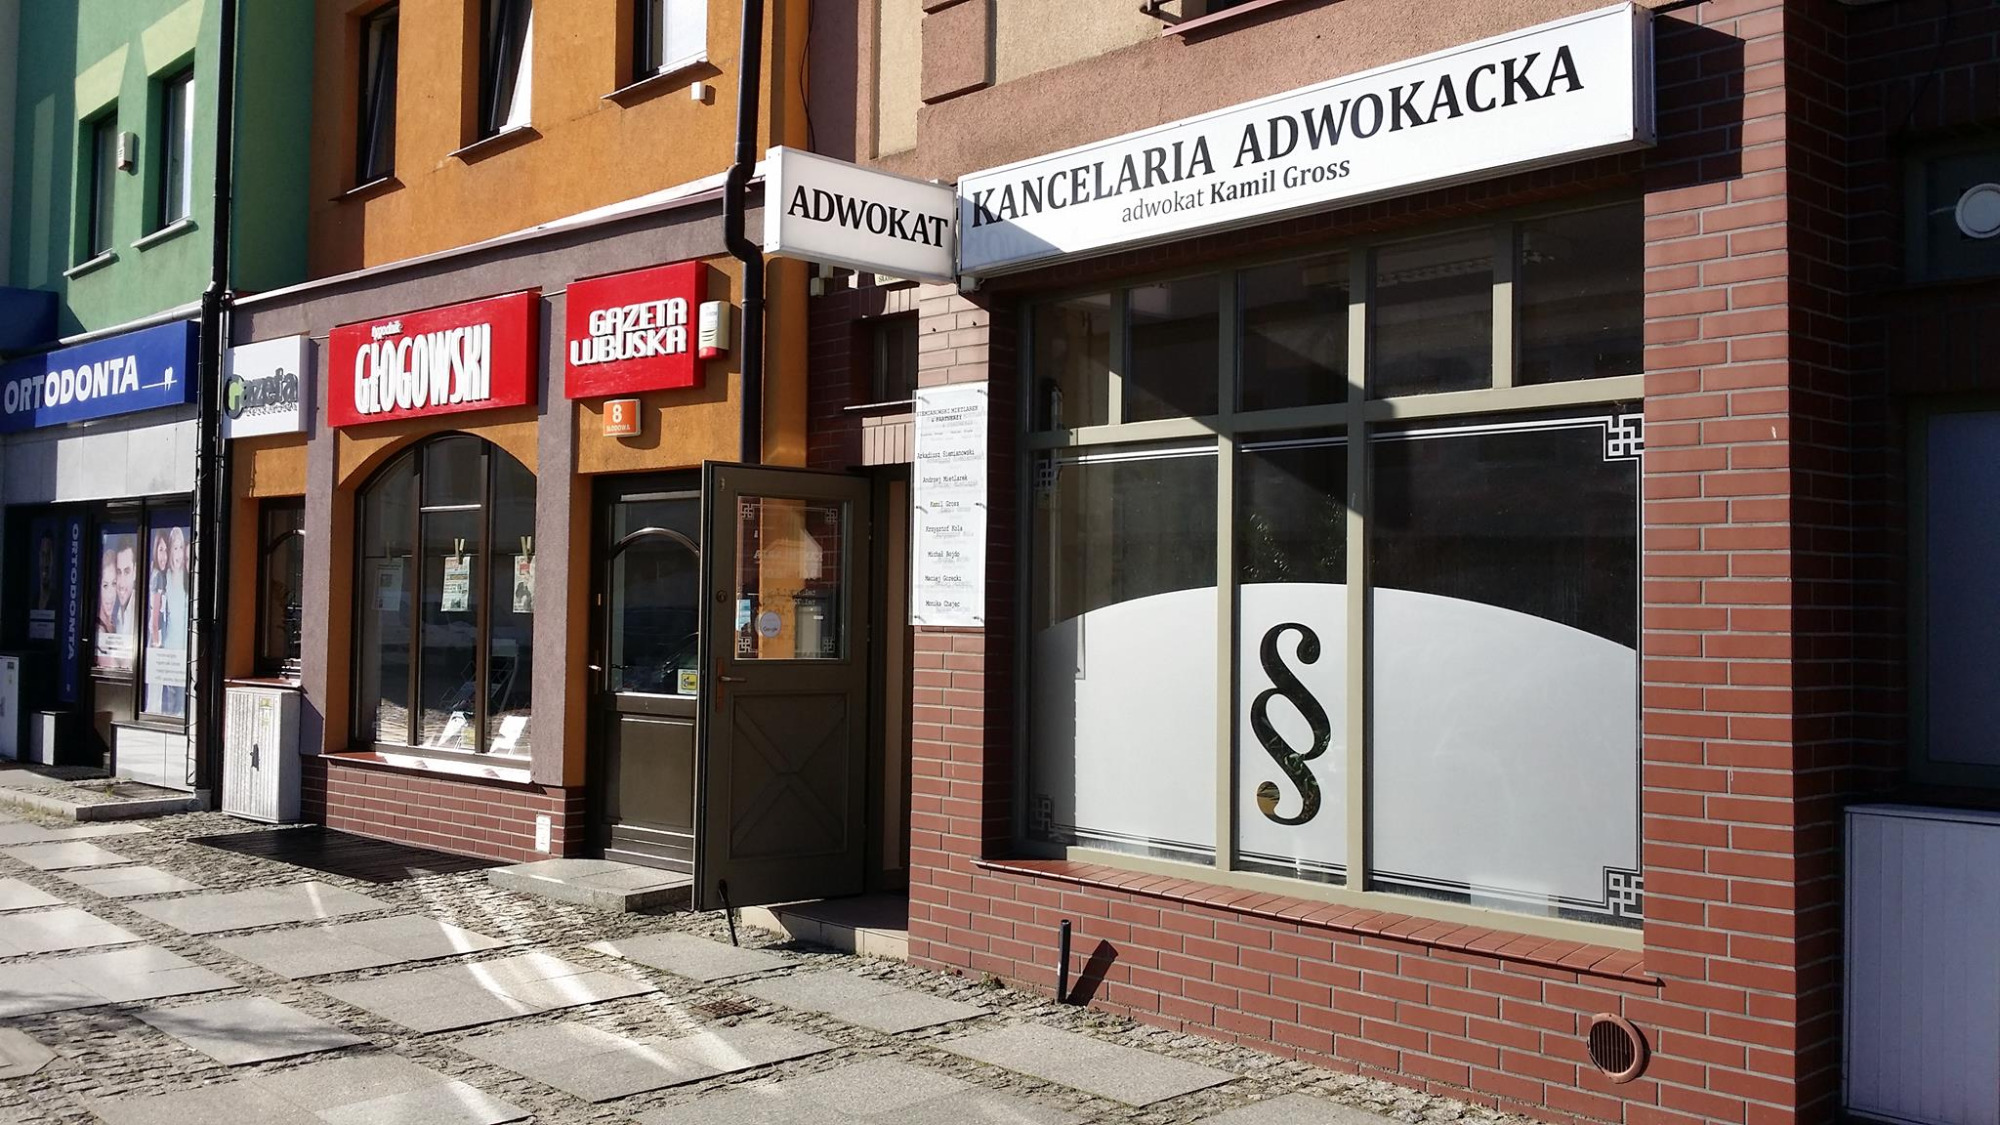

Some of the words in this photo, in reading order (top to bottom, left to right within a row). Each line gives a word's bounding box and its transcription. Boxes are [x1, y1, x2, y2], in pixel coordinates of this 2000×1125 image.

[971, 136, 1215, 228] KANCELARIA
[1232, 44, 1584, 169] ADWOKACKA
[787, 184, 949, 248] ADWOKAT
[1121, 188, 1204, 222] adwokat
[1210, 169, 1276, 205] Kamil
[1283, 159, 1350, 189] Gross
[569, 325, 688, 367] LUBUSKA
[588, 297, 688, 337] GAZETA
[4, 354, 139, 414] ORTODONTA
[354, 322, 492, 415] GŁOGOWSKI
[612, 403, 623, 424] 8
[67, 523, 80, 660] ORTODONTA
